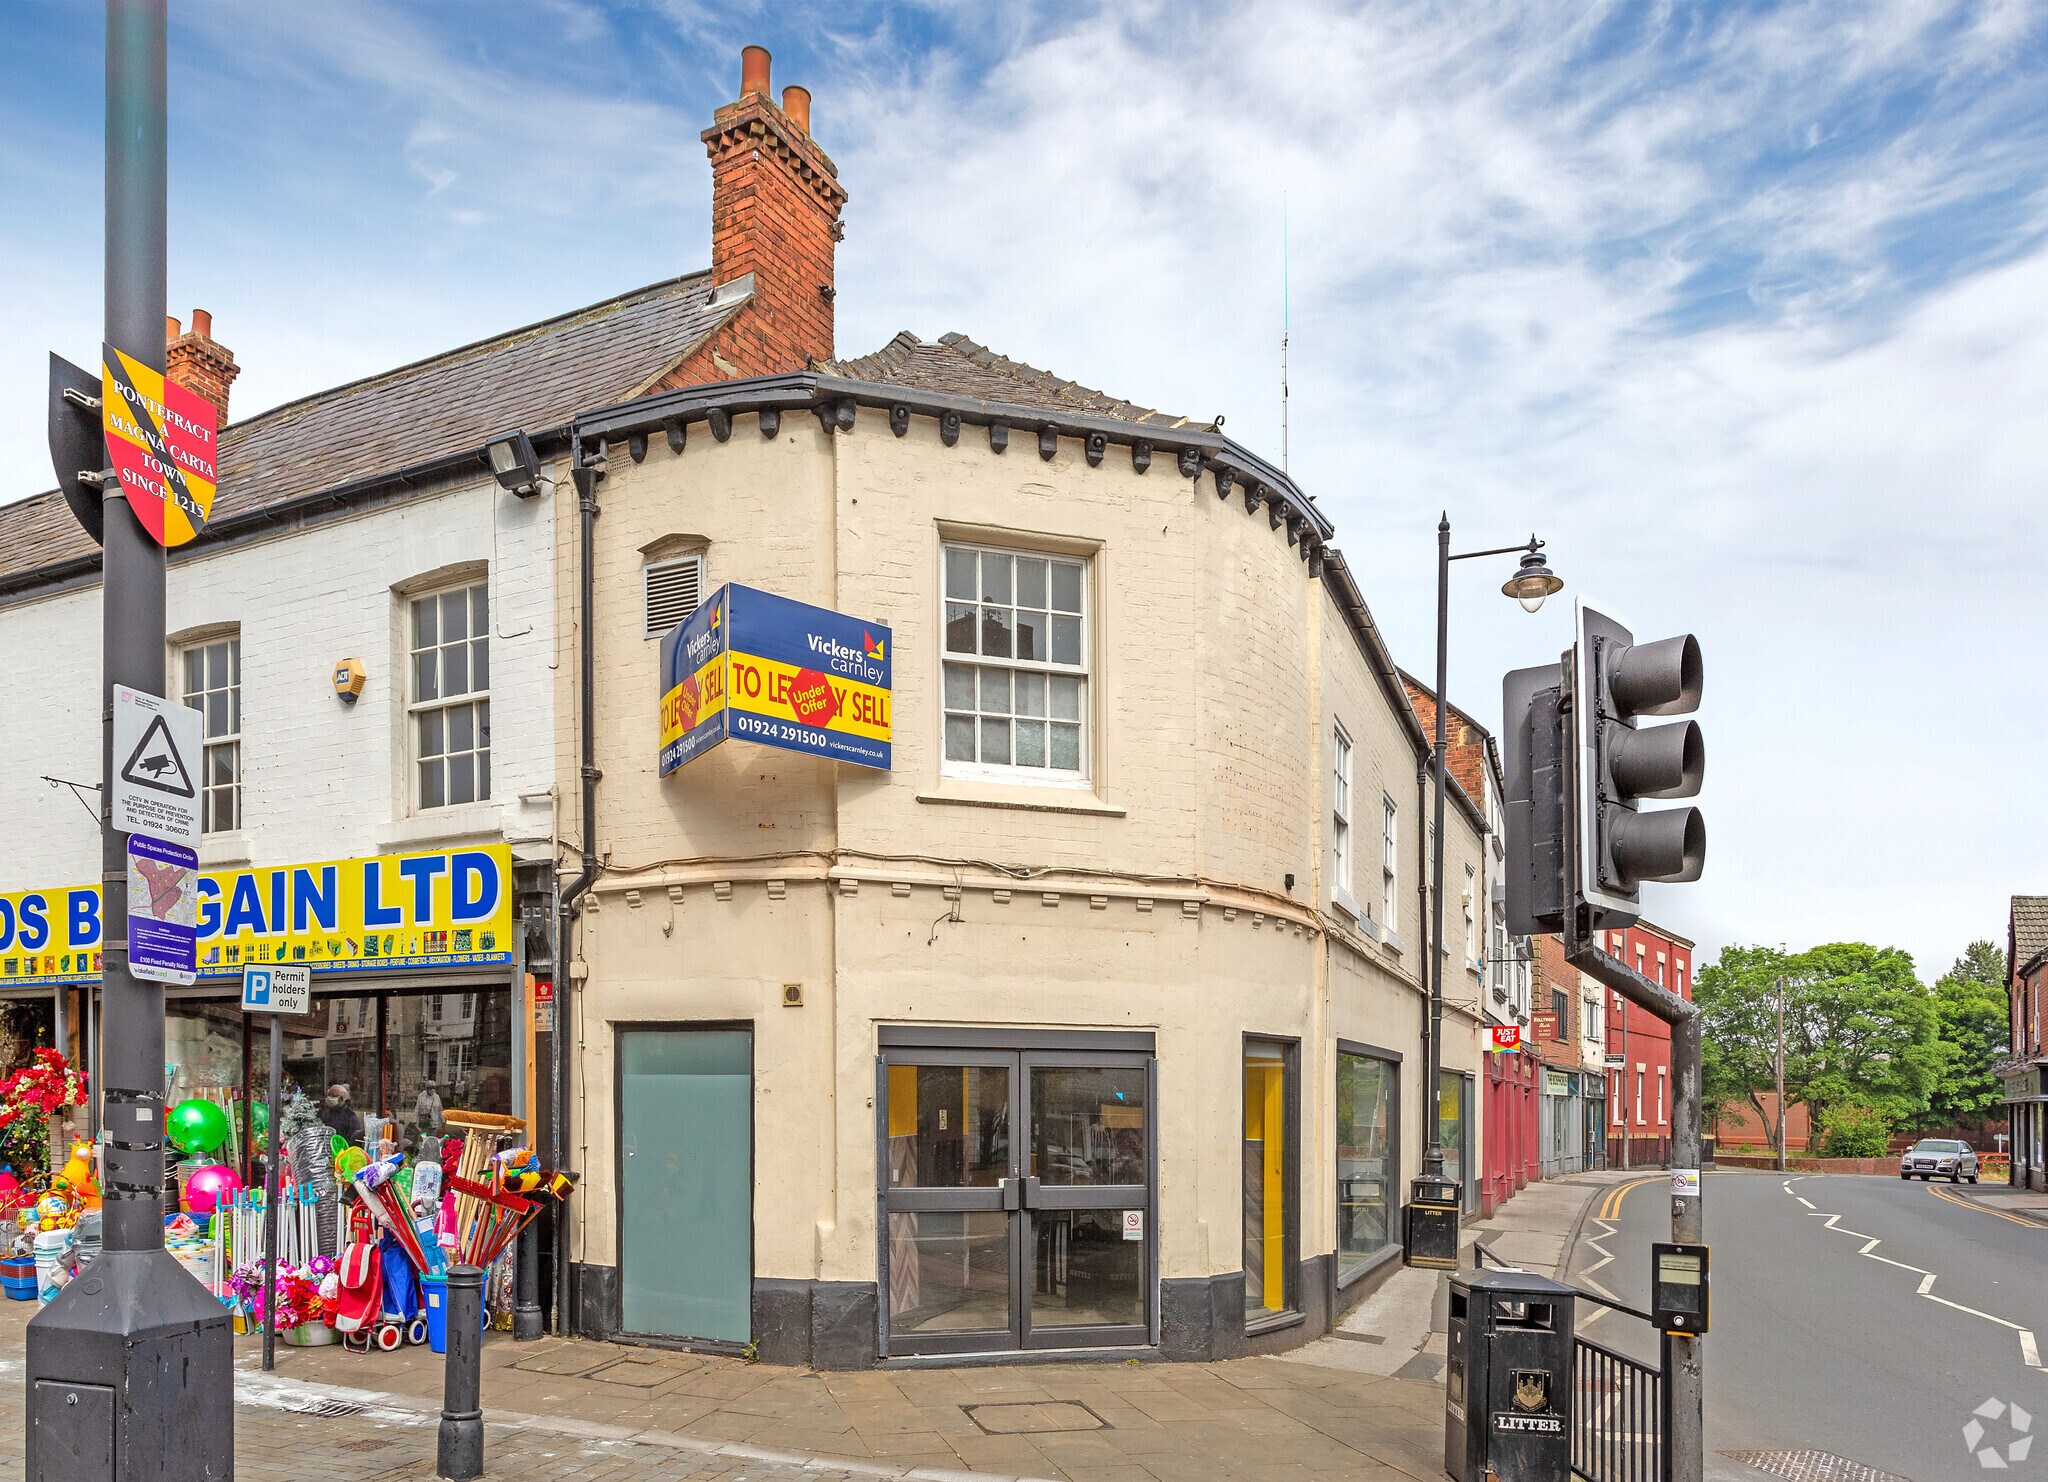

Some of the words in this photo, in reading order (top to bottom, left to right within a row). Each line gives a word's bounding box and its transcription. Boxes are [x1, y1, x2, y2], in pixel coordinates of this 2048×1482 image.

[113, 379, 211, 442] PONTEFRACT
[159, 422, 170, 438] A
[110, 412, 167, 454] MAGNA
[169, 445, 215, 478] CARTA
[141, 452, 187, 486] TOWN
[122, 468, 168, 500] SINCE
[172, 492, 205, 518] 1215
[686, 630, 711, 658] Vickers
[697, 635, 721, 664] carnley
[807, 633, 864, 663] Vickers
[337, 671, 348, 681] ADT
[830, 658, 884, 685] carnley
[661, 704, 670, 736] TO
[705, 665, 724, 704] SELL
[682, 685, 697, 706] Under
[733, 663, 761, 698] TO
[852, 691, 888, 728] SELL
[793, 684, 826, 704] Under
[800, 697, 828, 715] Offer
[738, 717, 778, 737] 01924
[781, 726, 827, 747] 291500
[830, 742, 884, 758] vickerscarnley.co.uk
[661, 747, 676, 767] 01924
[676, 735, 696, 758] 291500
[133, 802, 156, 812] PURPOSE
[165, 810, 194, 821] PREVENTION
[150, 800, 177, 812] OPERATION
[126, 815, 141, 825] TEL.
[142, 819, 163, 829] 01924
[165, 824, 189, 836] 306073
[138, 809, 166, 821] DETECTION
[175, 818, 190, 826] CRIME
[133, 840, 147, 849] Public
[147, 843, 163, 853] Spaces
[162, 848, 182, 858] Protection
[182, 853, 194, 861] Order
[363, 851, 502, 929] LTD
[151, 957, 161, 965] Fixed
[162, 959, 176, 968] Penalty
[176, 961, 189, 969] Notice
[408, 957, 427, 965] COSMETICS
[453, 955, 470, 963] FLOWERS
[472, 954, 484, 962] VASES
[486, 953, 505, 961] BLANKETS
[275, 970, 305, 981] Permit
[251, 975, 267, 1001] P
[272, 983, 306, 995] holders
[279, 997, 298, 1009] only
[1496, 1028, 1517, 1037] JUST
[1447, 1399, 1465, 1421] LITTER
[1497, 1416, 1561, 1432] LITTER
